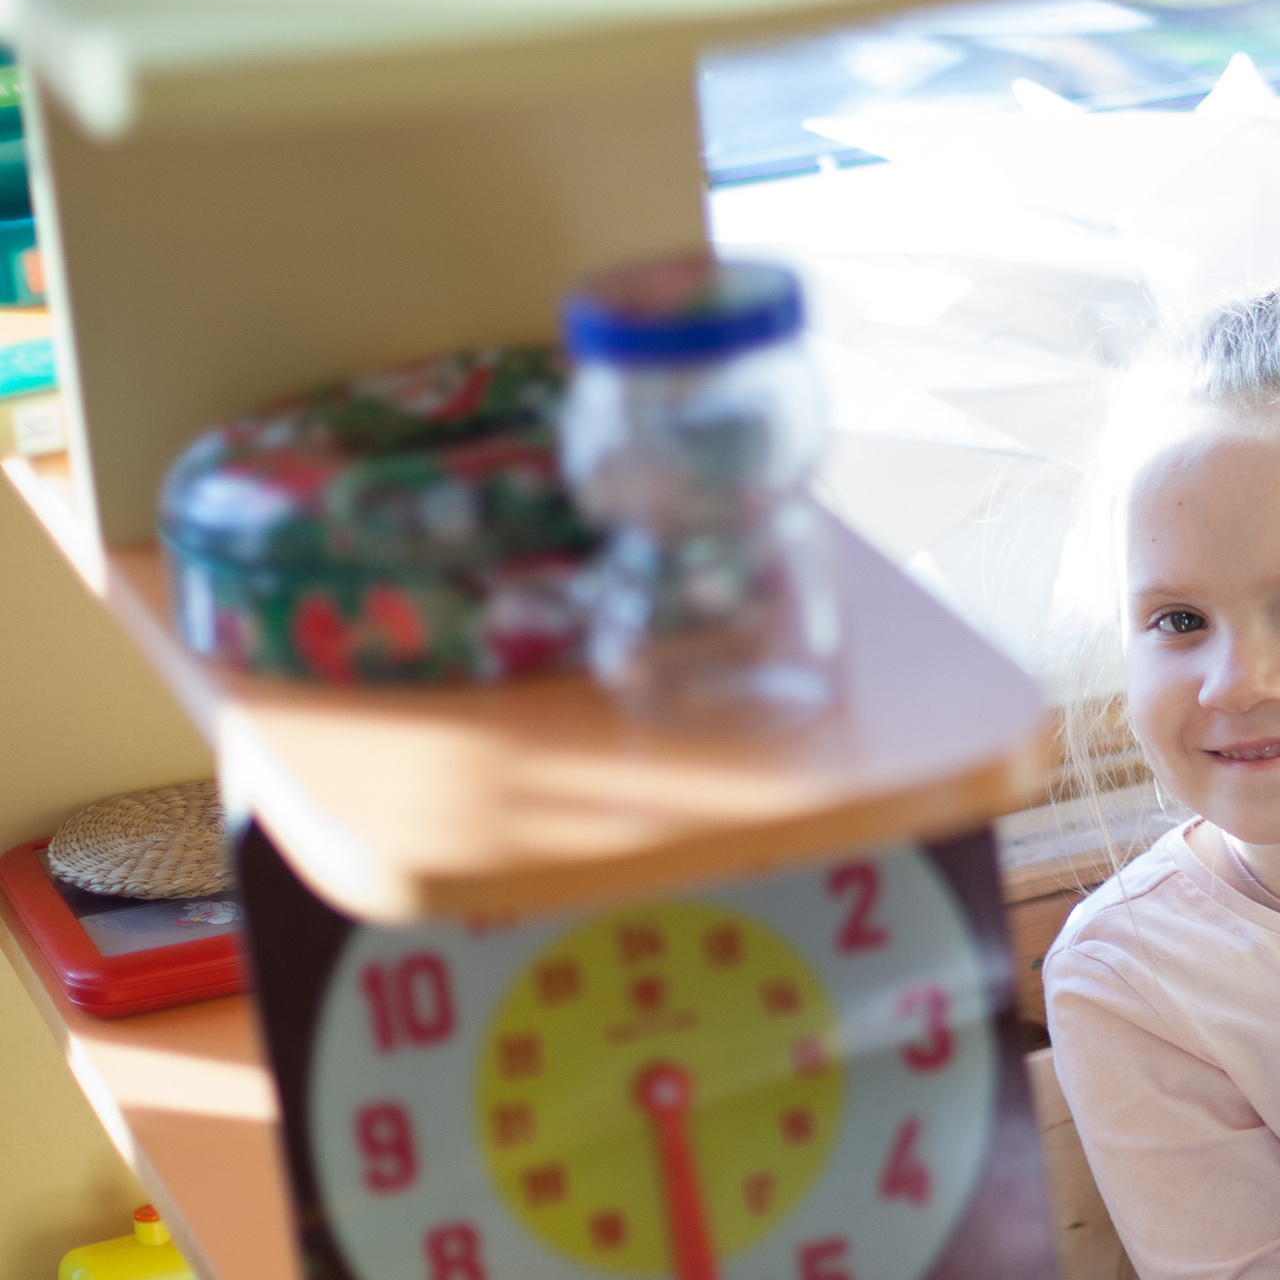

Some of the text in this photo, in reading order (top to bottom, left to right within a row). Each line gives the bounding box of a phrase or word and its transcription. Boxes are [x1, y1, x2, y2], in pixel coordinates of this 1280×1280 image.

[827, 861, 888, 956] 2
[359, 951, 458, 1054] 10
[897, 984, 957, 1075] 3
[354, 1102, 420, 1195] 9
[878, 1118, 932, 1207] 4
